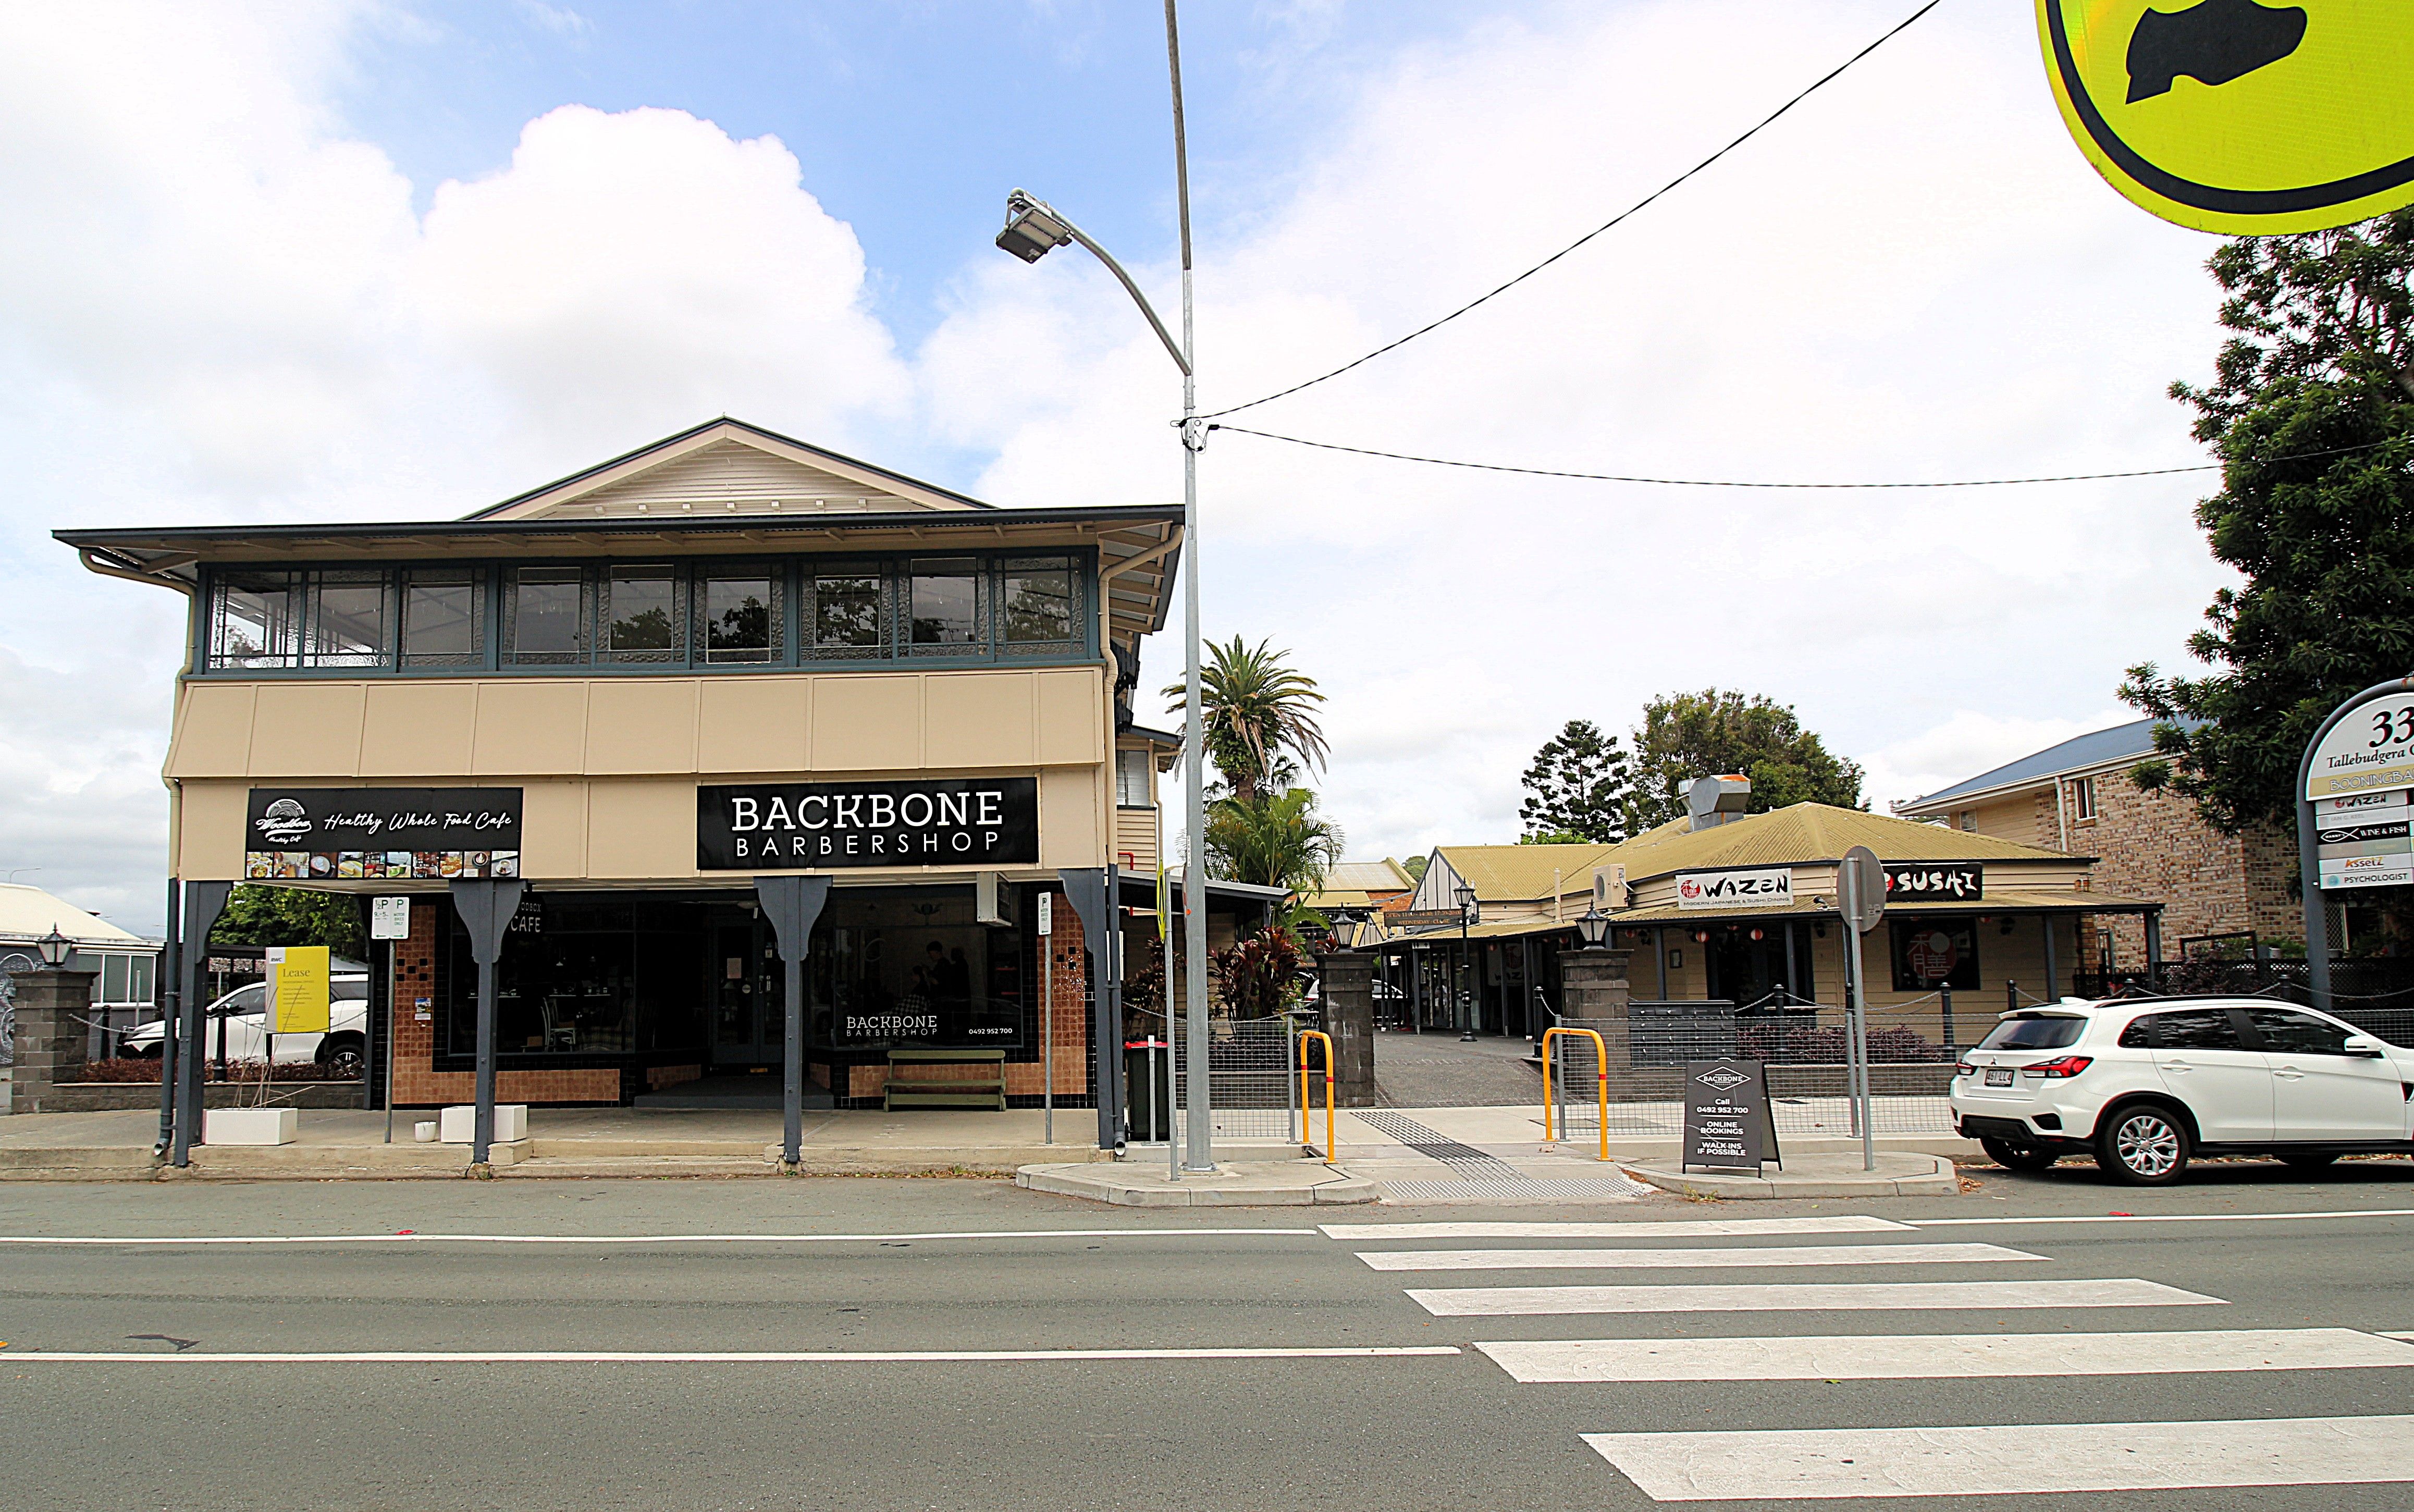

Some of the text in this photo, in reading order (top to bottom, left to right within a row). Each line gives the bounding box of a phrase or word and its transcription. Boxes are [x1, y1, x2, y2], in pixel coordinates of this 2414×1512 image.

[2327, 749, 2405, 769] Tallebudgera
[2330, 768, 2414, 792] BOONINGBA
[2346, 794, 2386, 807] WAZEN
[732, 791, 1002, 831] BACKBONE
[324, 812, 512, 834] Healthy Whole Food Cafe
[736, 832, 998, 857] BARBERSHOP
[1703, 874, 1788, 898] WAZEN
[1897, 870, 1978, 896] SUSHI
[2344, 873, 2408, 883] PSYCHOLOGIST
[397, 899, 404, 909] P
[521, 902, 541, 912] ODBOX
[511, 915, 540, 932] CAFE
[283, 968, 311, 977] Lease
[846, 1015, 937, 1028] BACKBONE
